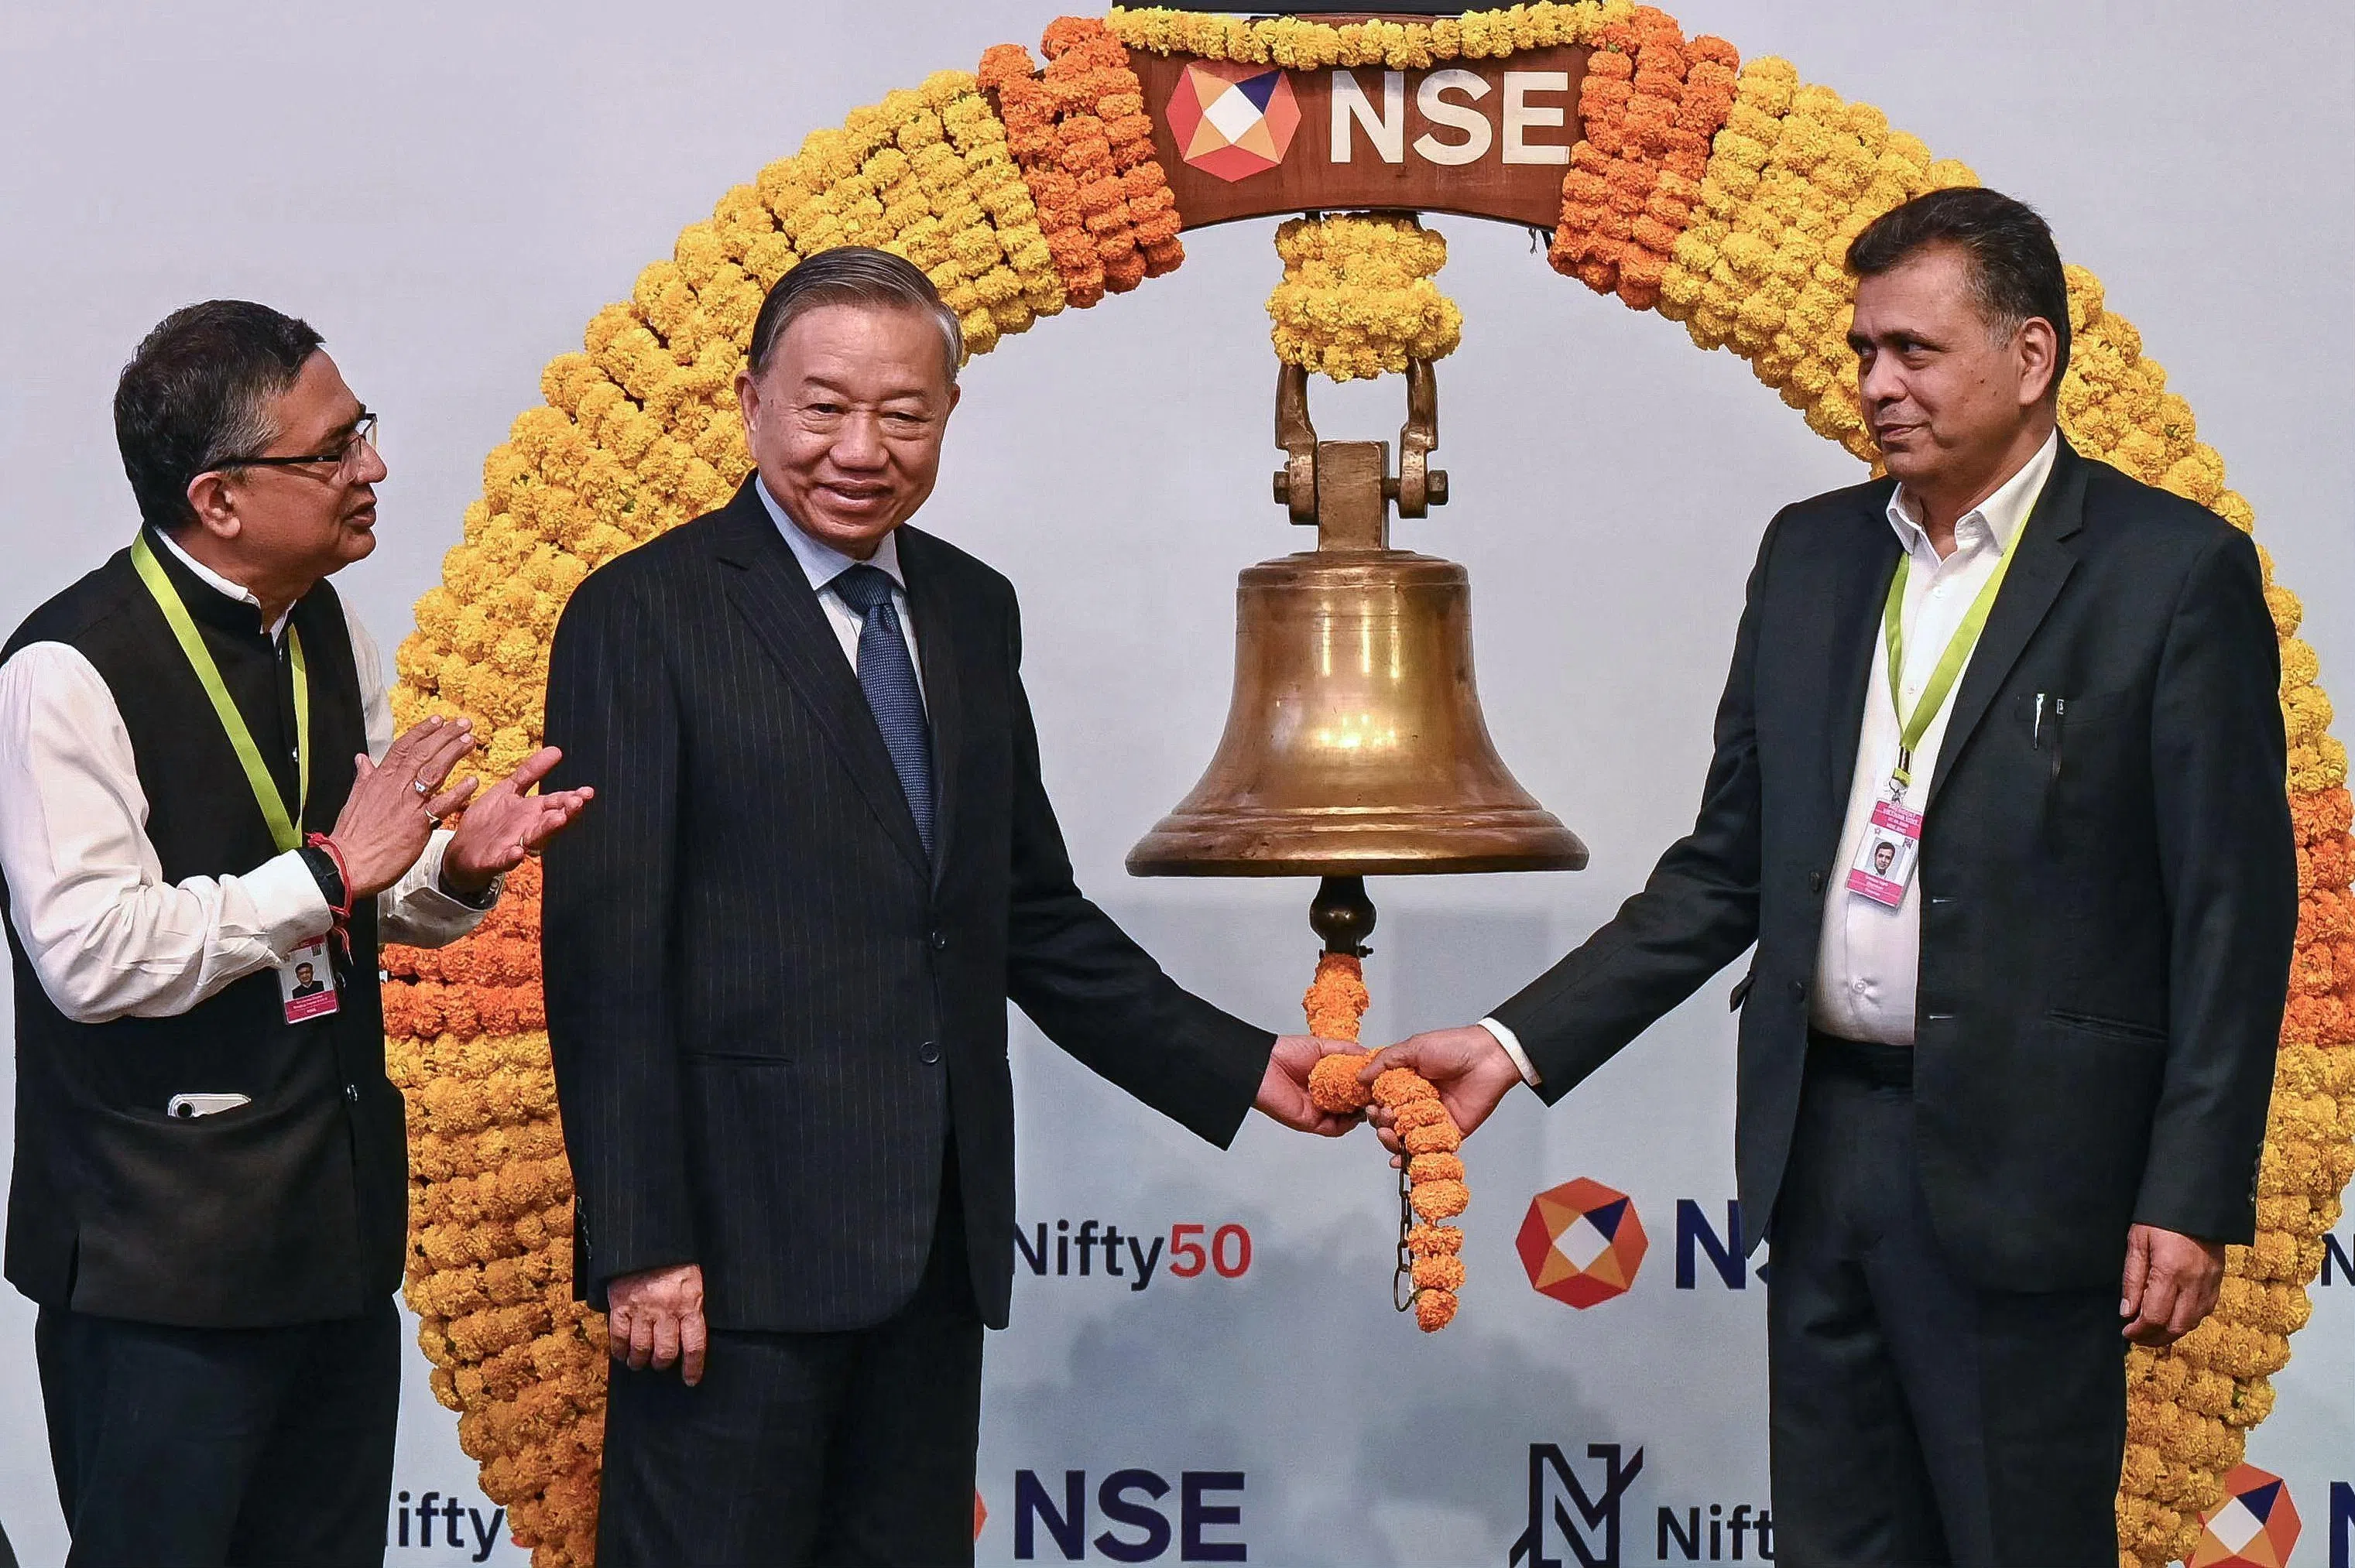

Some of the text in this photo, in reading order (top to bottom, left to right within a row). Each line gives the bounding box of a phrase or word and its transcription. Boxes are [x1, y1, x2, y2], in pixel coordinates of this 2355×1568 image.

[1331, 69, 1570, 166] NSE
[1015, 1219, 1252, 1292] Nifty50
[1676, 1199, 1770, 1290] N
[388, 1491, 523, 1563] ifty
[1014, 1468, 1247, 1563] NSE
[1657, 1504, 1775, 1560] Nift
